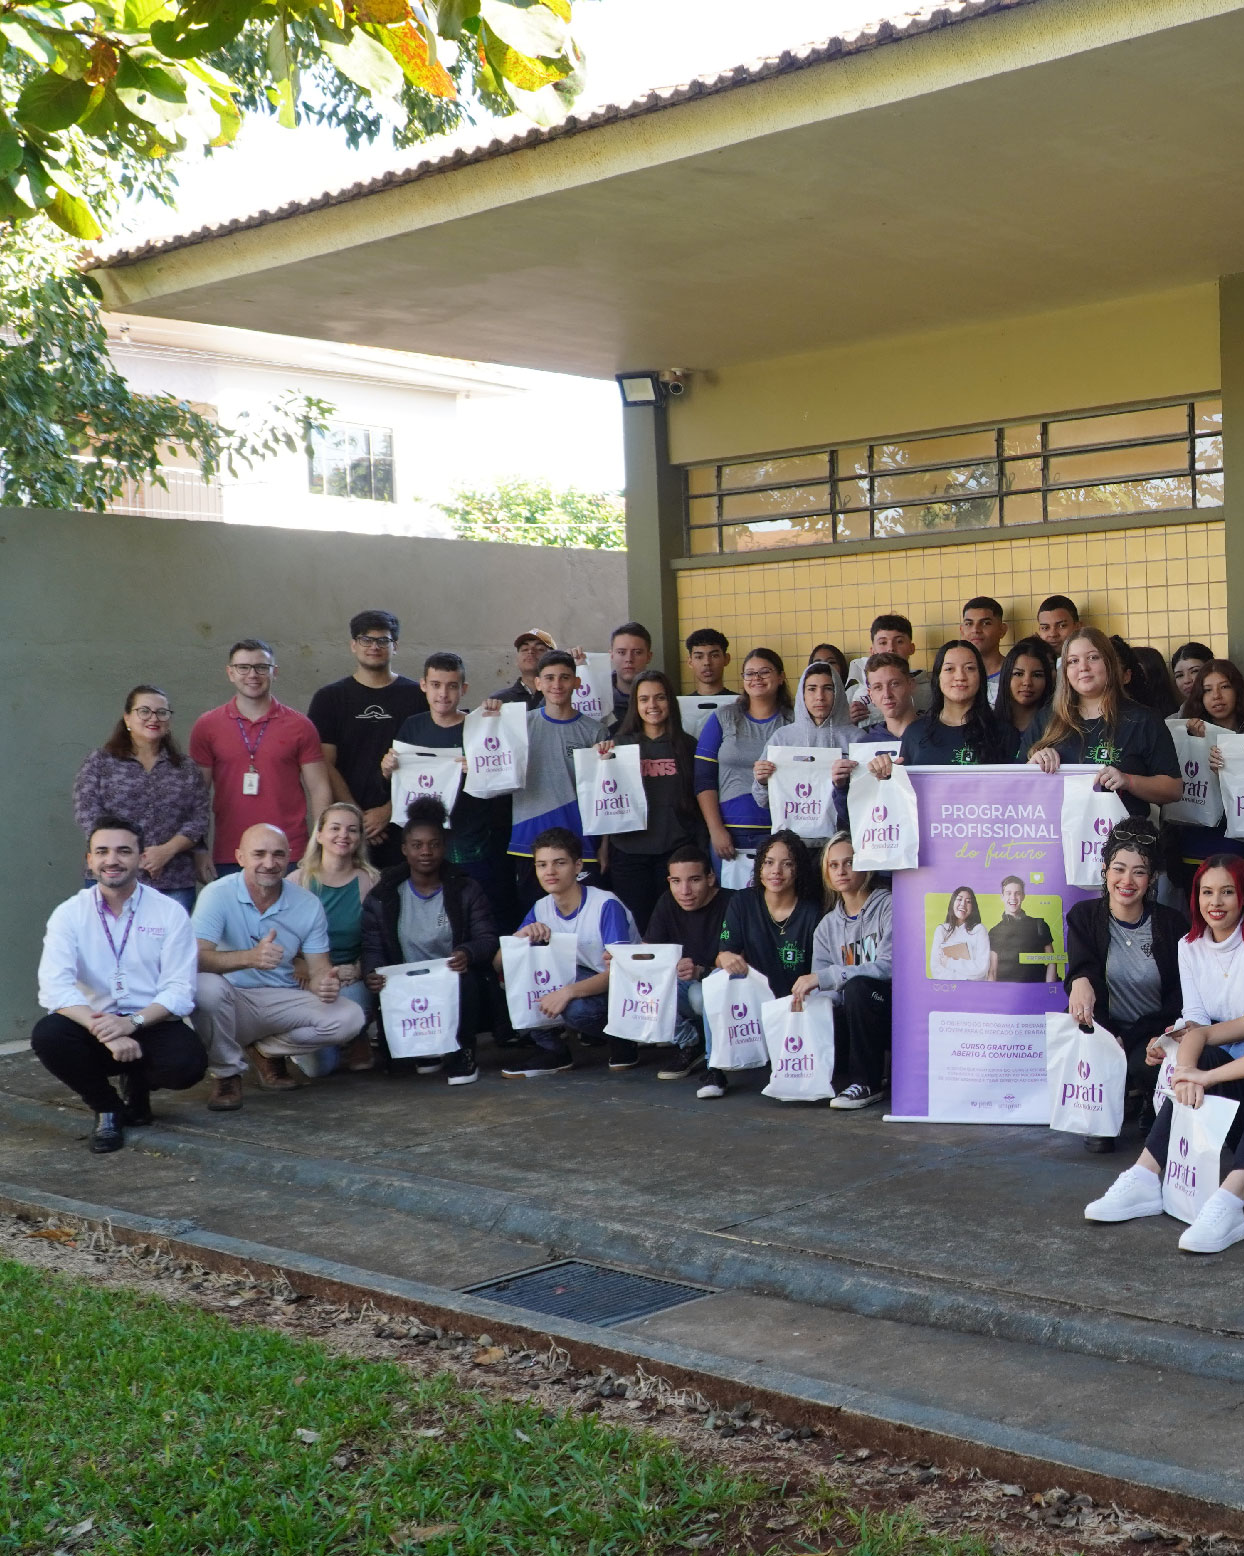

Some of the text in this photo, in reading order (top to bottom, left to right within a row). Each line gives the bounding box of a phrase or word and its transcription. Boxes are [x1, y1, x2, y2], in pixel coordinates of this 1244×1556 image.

[474, 750, 512, 774] prati
[641, 758, 678, 778] ANS
[1182, 780, 1209, 799] rati
[594, 793, 631, 816] prati
[784, 799, 822, 820] prati
[941, 804, 1046, 820] PROGRAMA
[862, 823, 900, 850] prati
[930, 823, 1059, 839] PROFISSIONAL
[955, 839, 1061, 869] do futuro
[621, 998, 661, 1018] prati
[401, 1011, 442, 1038] prati
[728, 1019, 761, 1046] prati
[951, 1050, 980, 1058] ABERTO
[988, 1051, 1044, 1059] COMUNIDADE
[960, 1042, 986, 1051] CURSO
[986, 1043, 1026, 1051] GRATUITO
[1061, 1083, 1103, 1106] prati
[1167, 1159, 1196, 1188] prati
